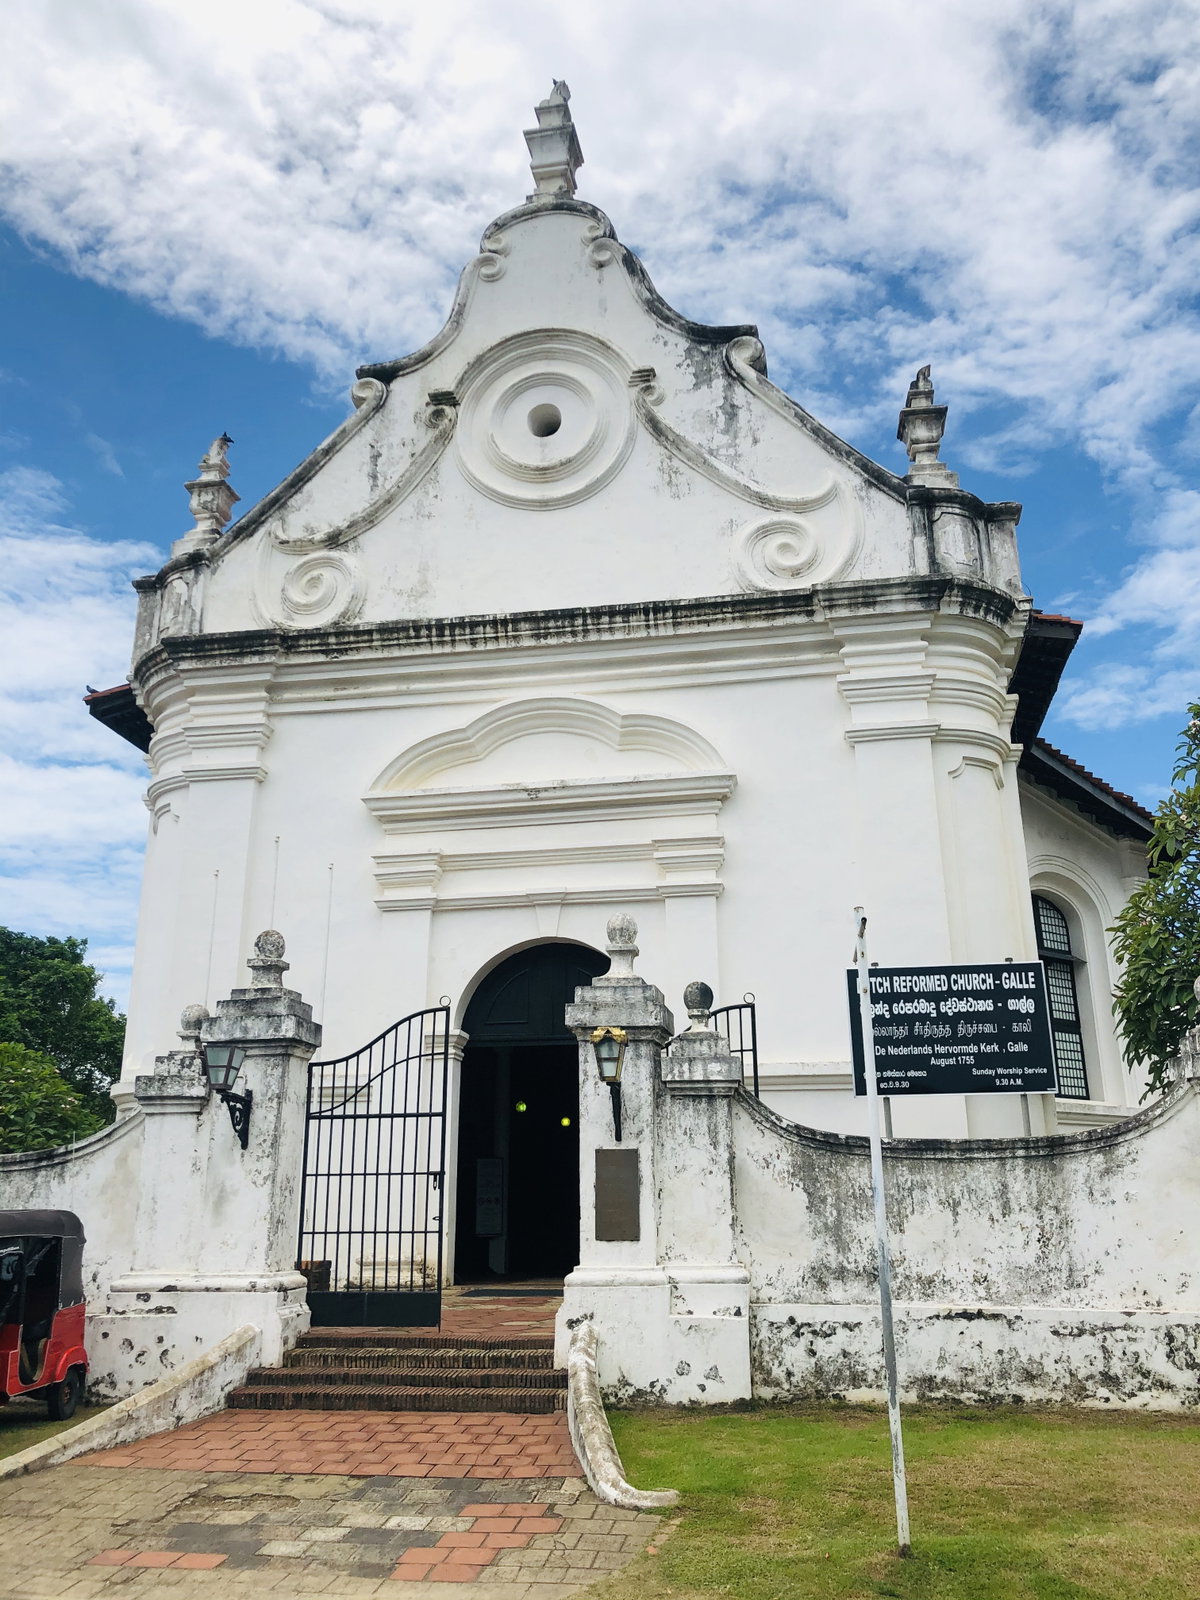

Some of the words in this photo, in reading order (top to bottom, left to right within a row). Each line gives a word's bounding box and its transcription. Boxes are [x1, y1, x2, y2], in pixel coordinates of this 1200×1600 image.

[856, 976, 891, 994] TCH
[893, 974, 948, 993] REFORMED
[950, 973, 994, 991] CHURCH
[1002, 972, 1036, 989] GALLE
[872, 1023, 909, 1039] ல்லாந்தர்
[875, 1045, 886, 1056] De
[888, 1044, 933, 1055] Nederlands
[934, 1043, 978, 1055] Hervormde
[980, 1042, 1000, 1053] Kerk
[1007, 1041, 1029, 1052] Galle
[930, 1056, 956, 1067] August
[957, 1055, 975, 1065] 1755
[972, 1067, 996, 1076] Sunday
[996, 1067, 1023, 1075] Worship
[1024, 1066, 1048, 1074] Service
[995, 1078, 1009, 1086] 9.30
